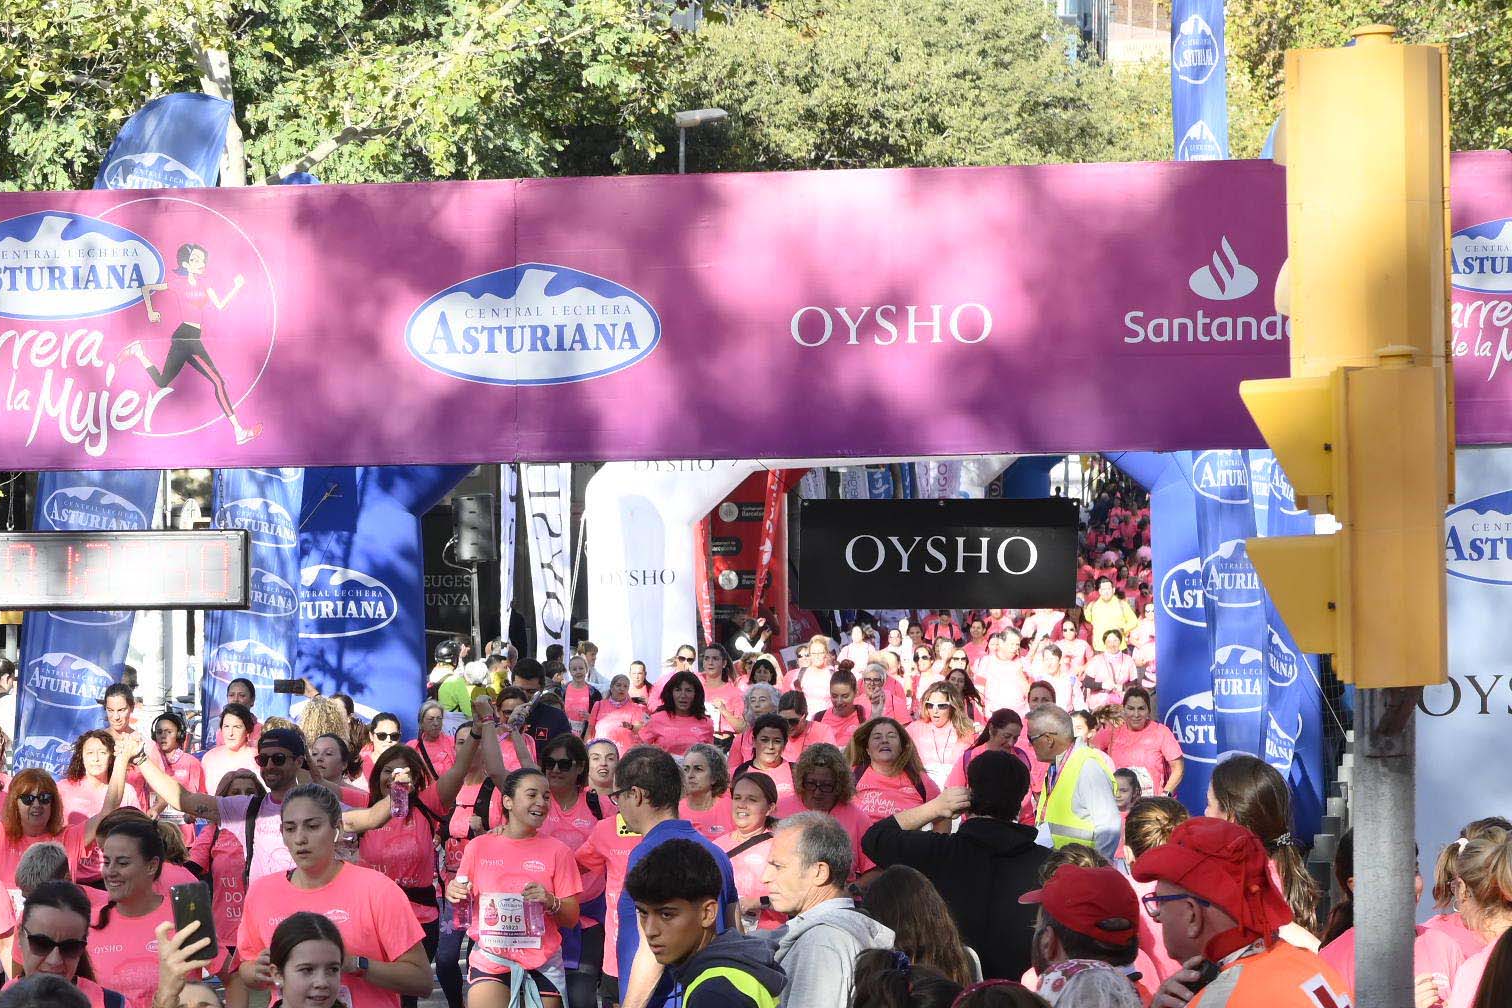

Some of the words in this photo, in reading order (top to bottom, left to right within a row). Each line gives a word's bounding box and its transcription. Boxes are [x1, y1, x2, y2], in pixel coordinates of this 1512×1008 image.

[67, 246, 140, 259] LECHERA
[1464, 244, 1510, 254] CENTRA
[464, 305, 543, 319] CENTRAL
[551, 303, 632, 318] LECHERA
[426, 311, 641, 355] ASTURIANA
[790, 302, 994, 348] OYSHO
[1123, 308, 1291, 344] Santand
[6, 376, 31, 412] la
[26, 355, 175, 457] Mujer
[845, 534, 1038, 575] OYSHO
[334, 589, 383, 599] LECHERA
[220, 876, 238, 889] TU
[500, 914, 521, 924] 016
